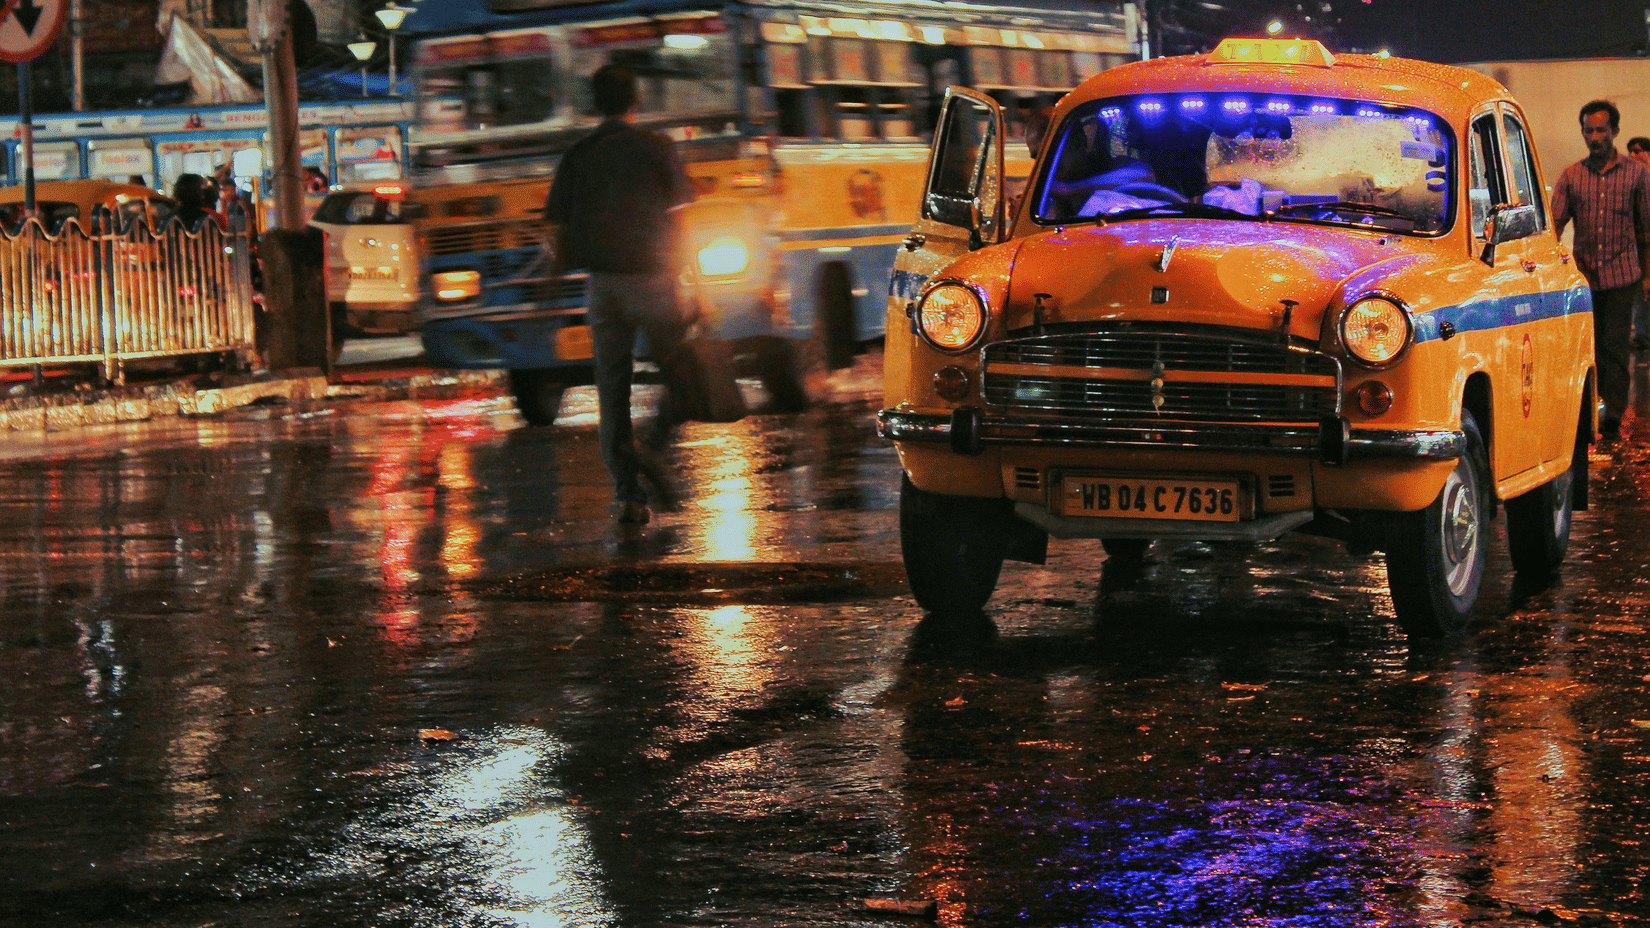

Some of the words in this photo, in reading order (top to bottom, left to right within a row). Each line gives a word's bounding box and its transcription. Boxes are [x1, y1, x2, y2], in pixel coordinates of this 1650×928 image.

[1082, 483, 1111, 510] WB
[1118, 485, 1147, 512] 04
[1154, 486, 1167, 512] C
[1173, 486, 1233, 514] 7636
